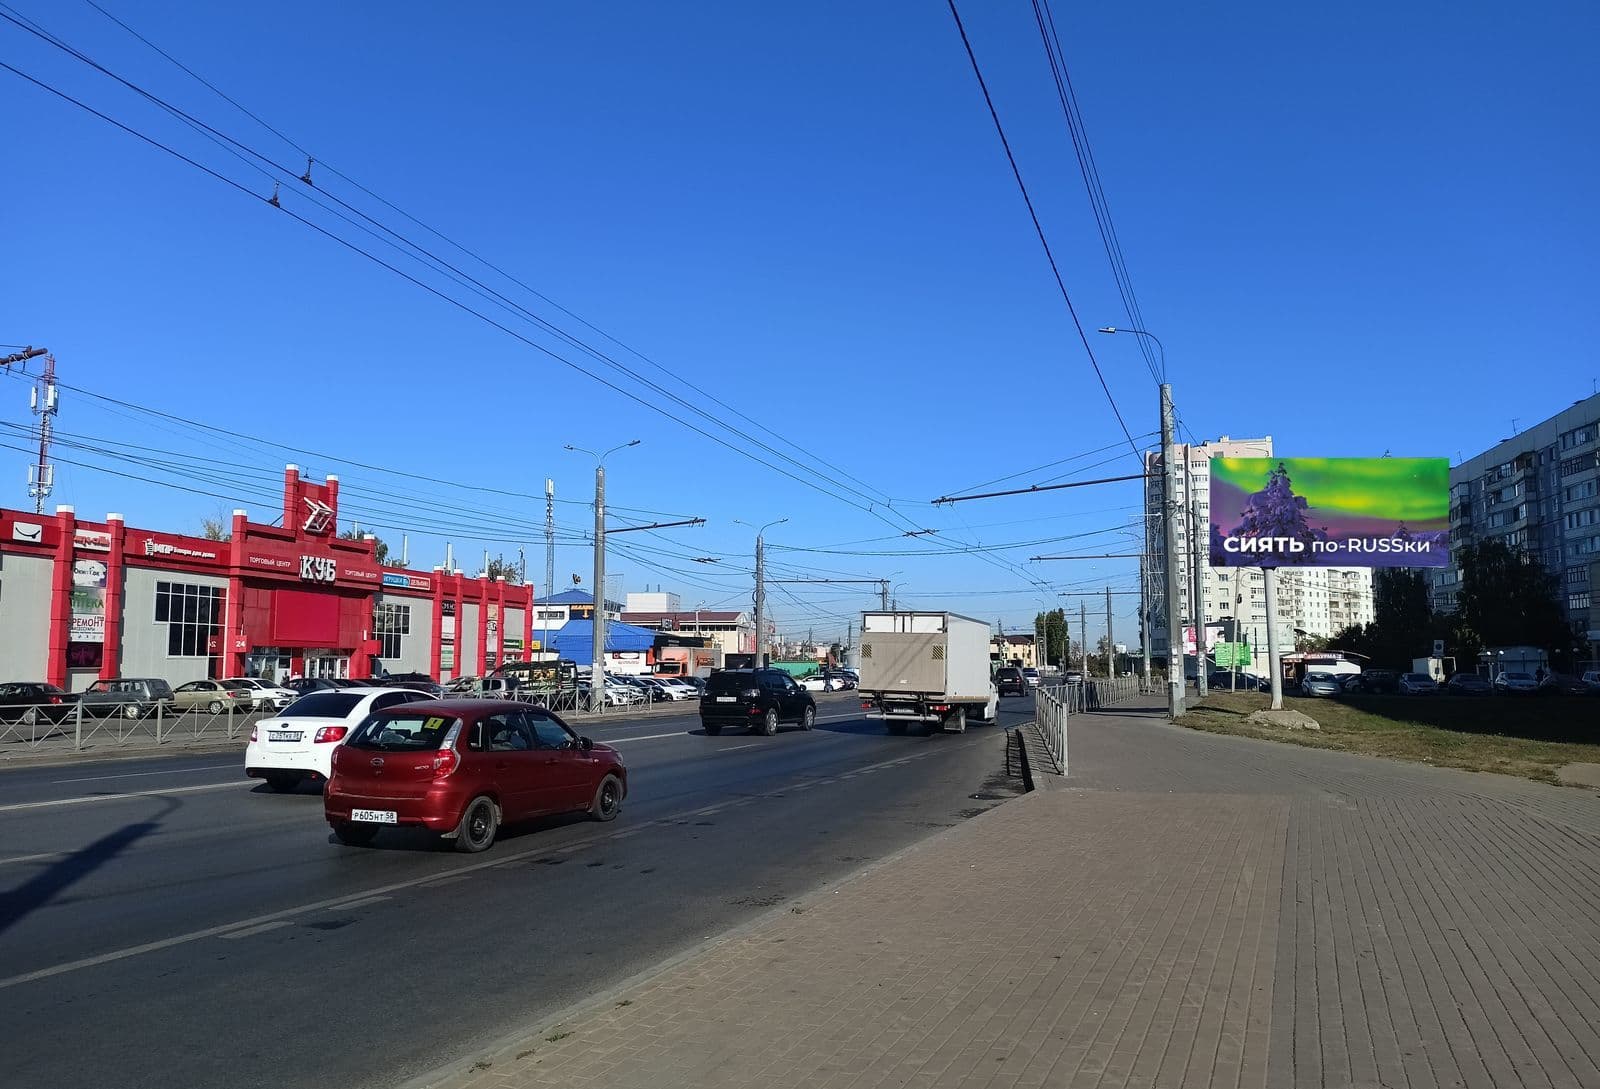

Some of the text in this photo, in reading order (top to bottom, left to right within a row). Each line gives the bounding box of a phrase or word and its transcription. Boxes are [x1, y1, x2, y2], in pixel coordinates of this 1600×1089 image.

[1223, 537, 1430, 553] СИЯТЬ по-RUSSки
[249, 556, 291, 568] ТОРГОВЫЙ ЦЕНТР
[300, 555, 337, 581] КУБ
[344, 569, 364, 577] ТОРГОВЫЙ
[72, 618, 104, 627] РЕМОНТ
[235, 640, 246, 648] 24
